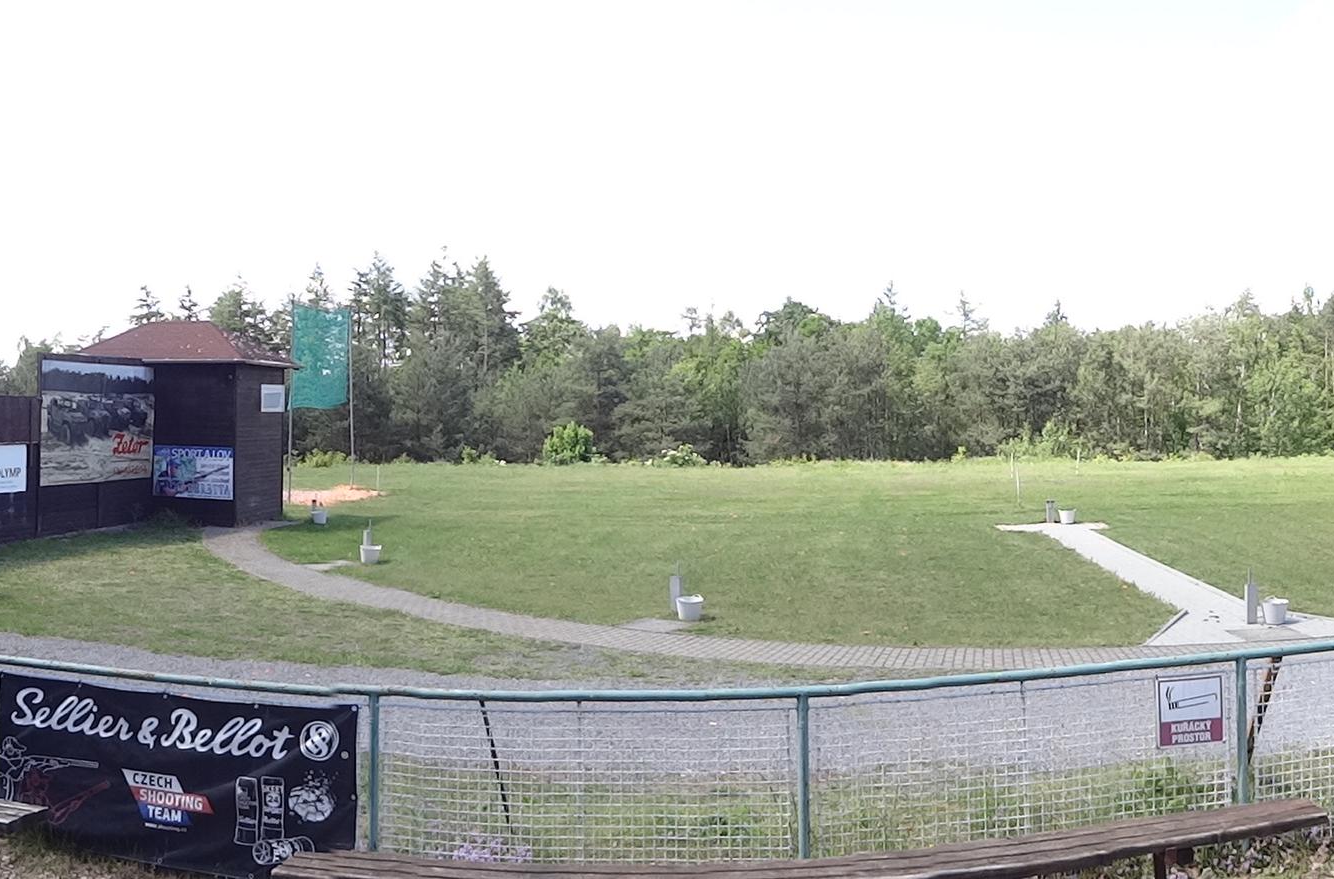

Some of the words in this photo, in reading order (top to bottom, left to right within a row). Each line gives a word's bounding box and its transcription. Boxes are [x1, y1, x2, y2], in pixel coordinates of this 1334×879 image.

[112, 433, 149, 456] Zetor
[171, 448, 203, 459] SPORT
[11, 687, 134, 741] Sellier
[137, 717, 159, 749] &
[160, 708, 295, 760] Bellot
[1171, 732, 1212, 744] PROSTOR
[133, 773, 173, 789] CZECH
[139, 789, 204, 811] SHOOTING
[147, 805, 182, 823] TEAM
